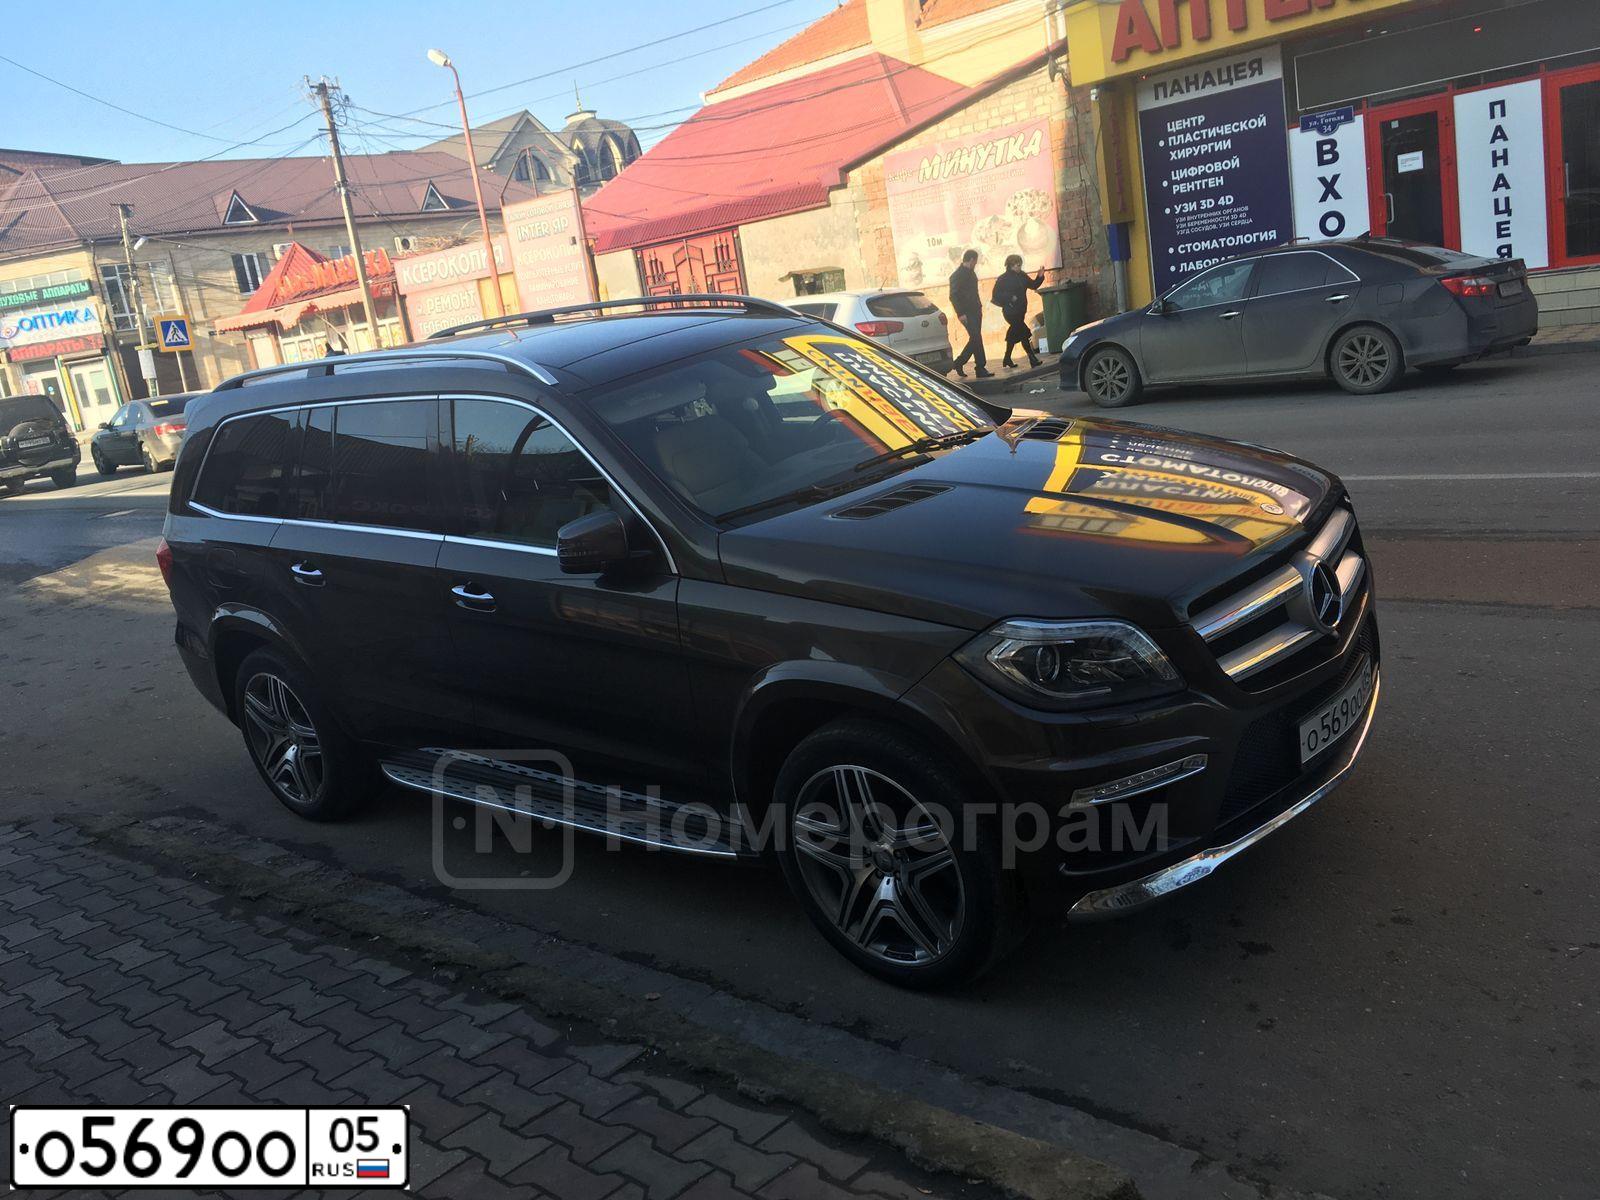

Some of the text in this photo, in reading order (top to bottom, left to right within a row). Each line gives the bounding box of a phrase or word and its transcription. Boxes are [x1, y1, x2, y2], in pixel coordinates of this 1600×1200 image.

[1153, 57, 1264, 101] ПАНАЦЕЯ
[1166, 115, 1206, 133] ЦЕНТР
[1168, 114, 1267, 147] ПЛАСТИЧЕСКОЙ
[918, 129, 1043, 184] МИНУТКА
[1169, 139, 1232, 161] ХИРУРГИИ
[1171, 156, 1240, 181] ЦИФРОВОЙ
[1172, 176, 1224, 194] РЕНТГЕН
[1174, 195, 1234, 214] УЗИ 3D 4D
[1222, 205, 1249, 216] ОРГАНОВ
[517, 221, 551, 243] INTER
[1177, 229, 1277, 255] СТОМАТОЛОГИЯ
[42, 282, 90, 299] АППАРАТЫ
[425, 290, 476, 314] РЕМОНТ
[18, 307, 97, 332] ОПТИКА
